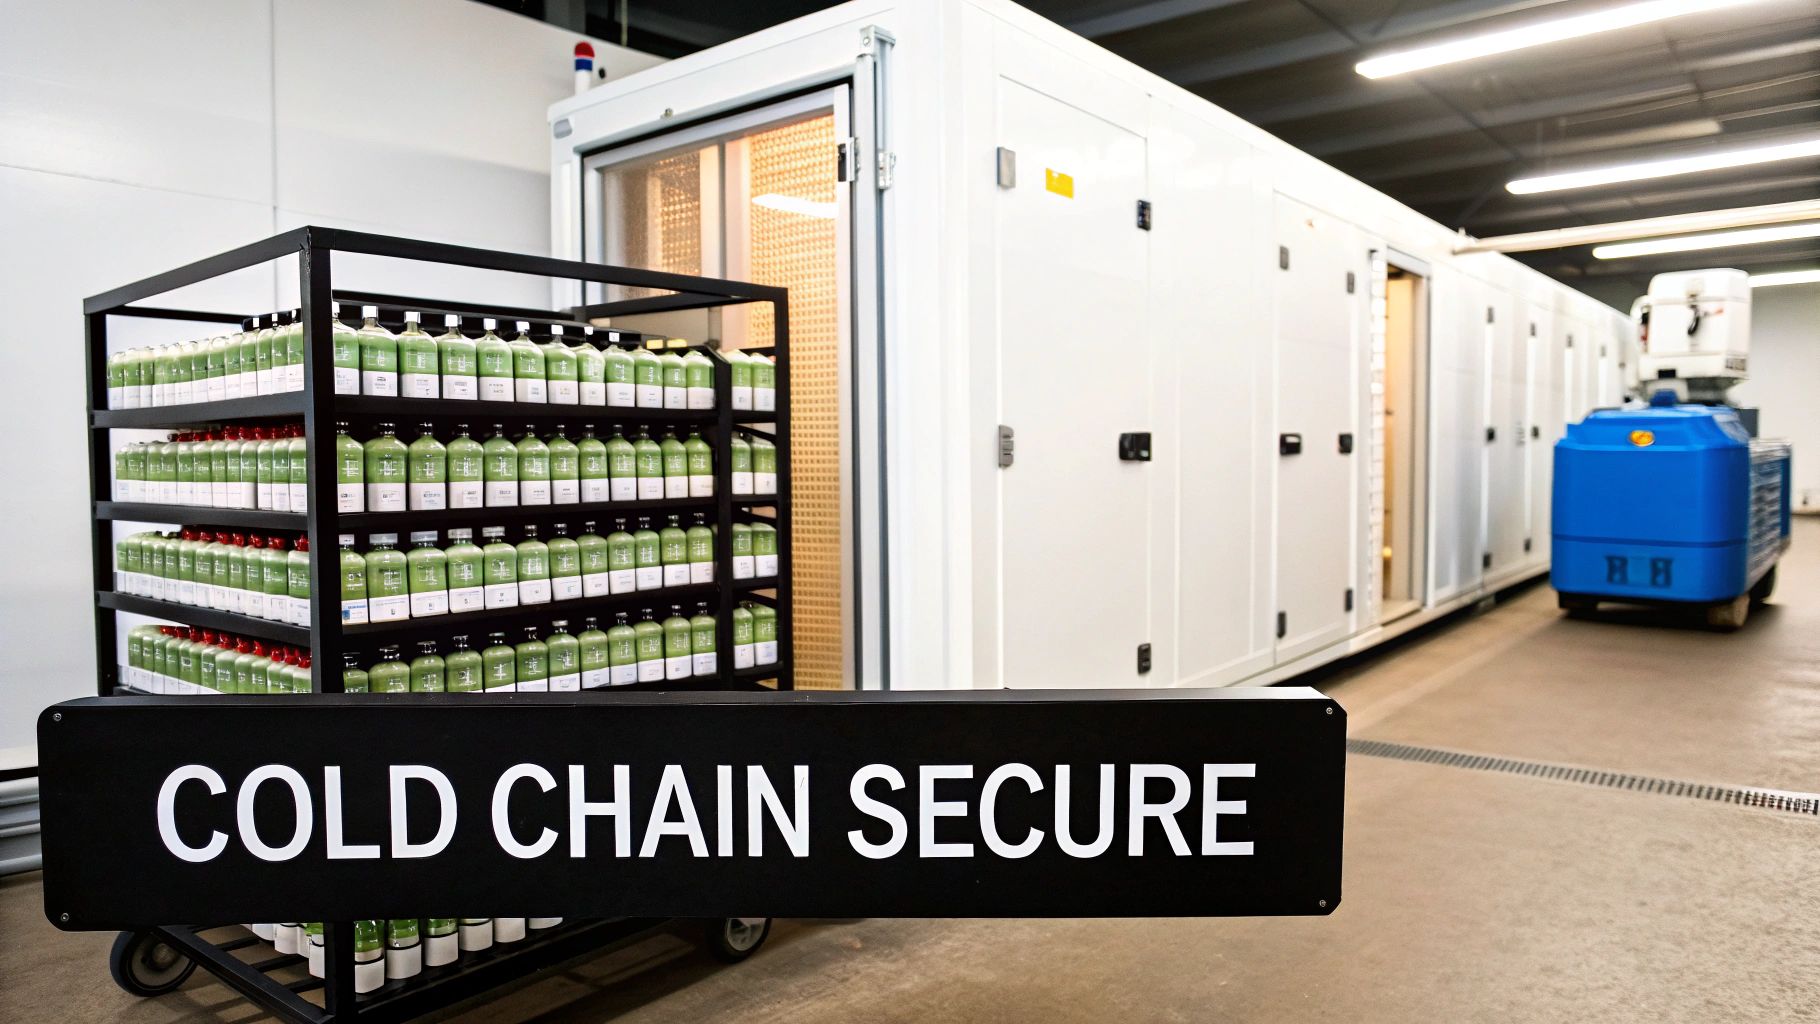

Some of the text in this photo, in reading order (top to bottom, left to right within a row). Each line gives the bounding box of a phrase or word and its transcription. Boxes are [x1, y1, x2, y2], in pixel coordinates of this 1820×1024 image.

[157, 763, 1257, 862] COLD CHAIN SECURE
